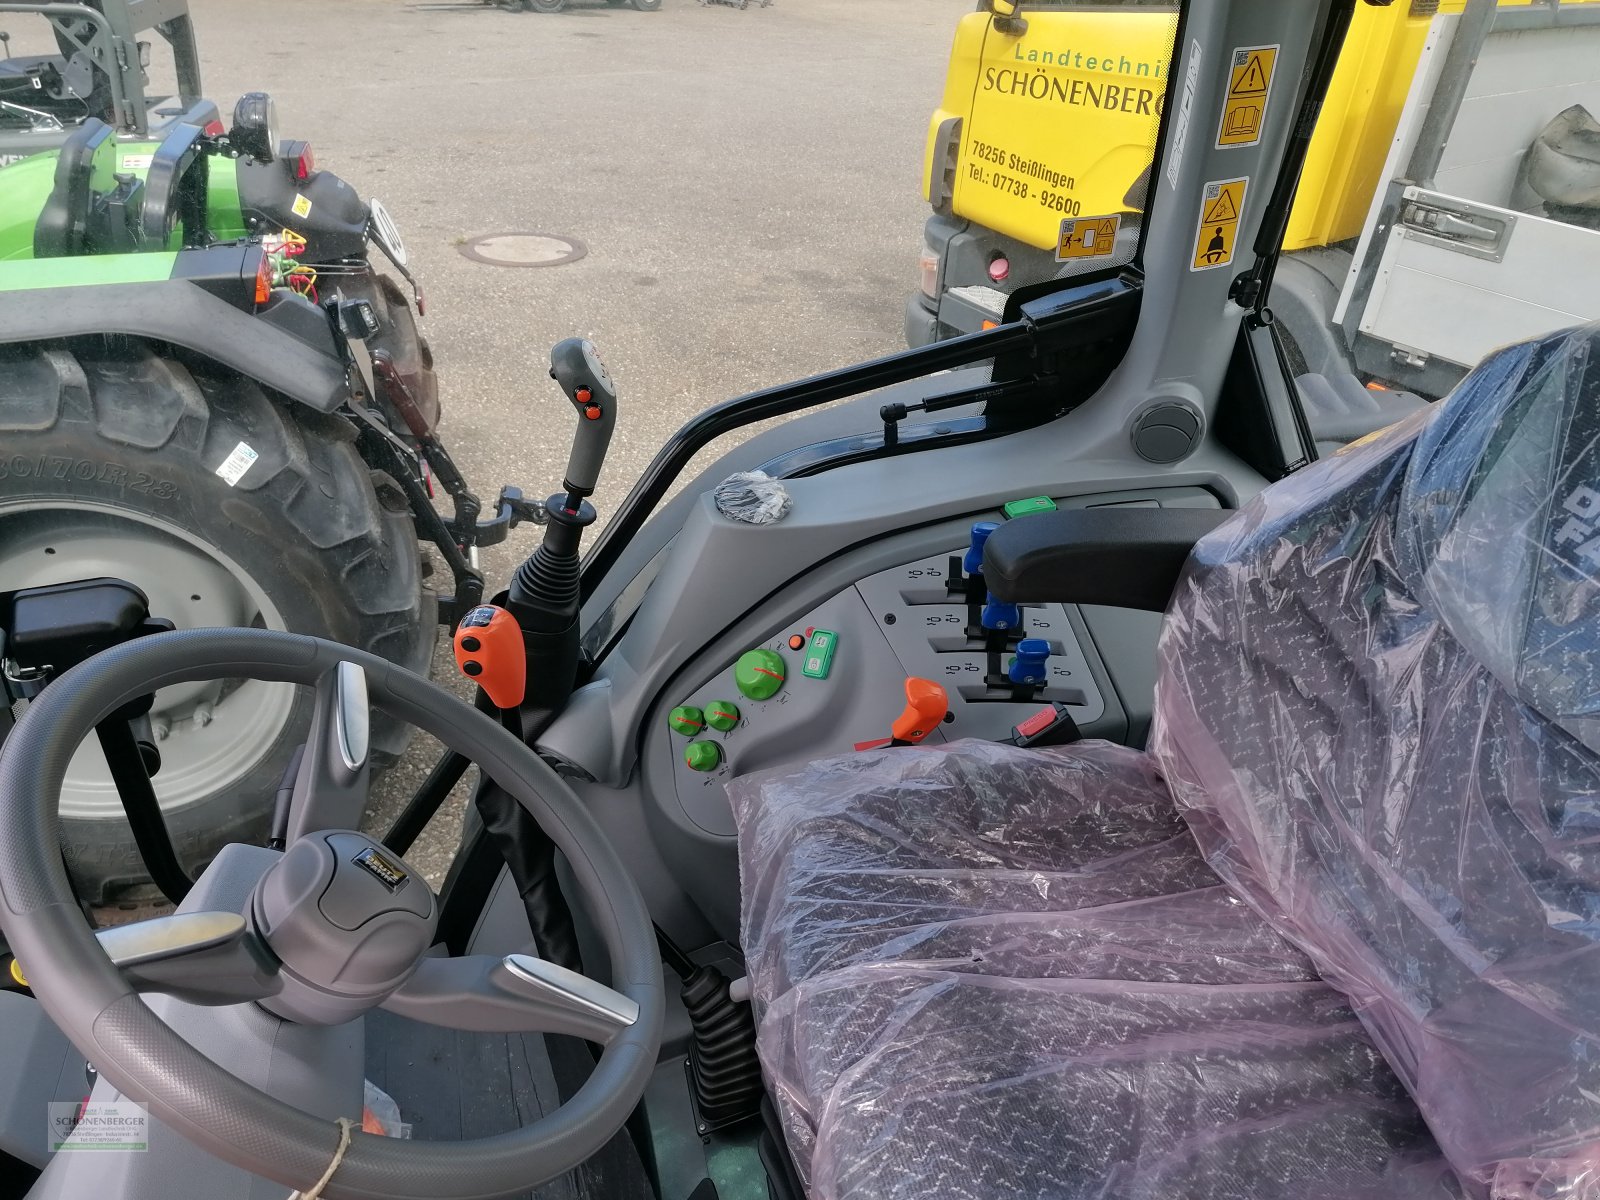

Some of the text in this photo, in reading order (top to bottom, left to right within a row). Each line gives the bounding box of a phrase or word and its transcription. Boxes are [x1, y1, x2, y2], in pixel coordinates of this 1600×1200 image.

[1014, 42, 1163, 78] Landtechni
[969, 163, 990, 185] Tel.:
[992, 172, 1029, 199] 07738
[1040, 190, 1081, 217] 92600
[972, 140, 1075, 191] 78256 Steißlingen
